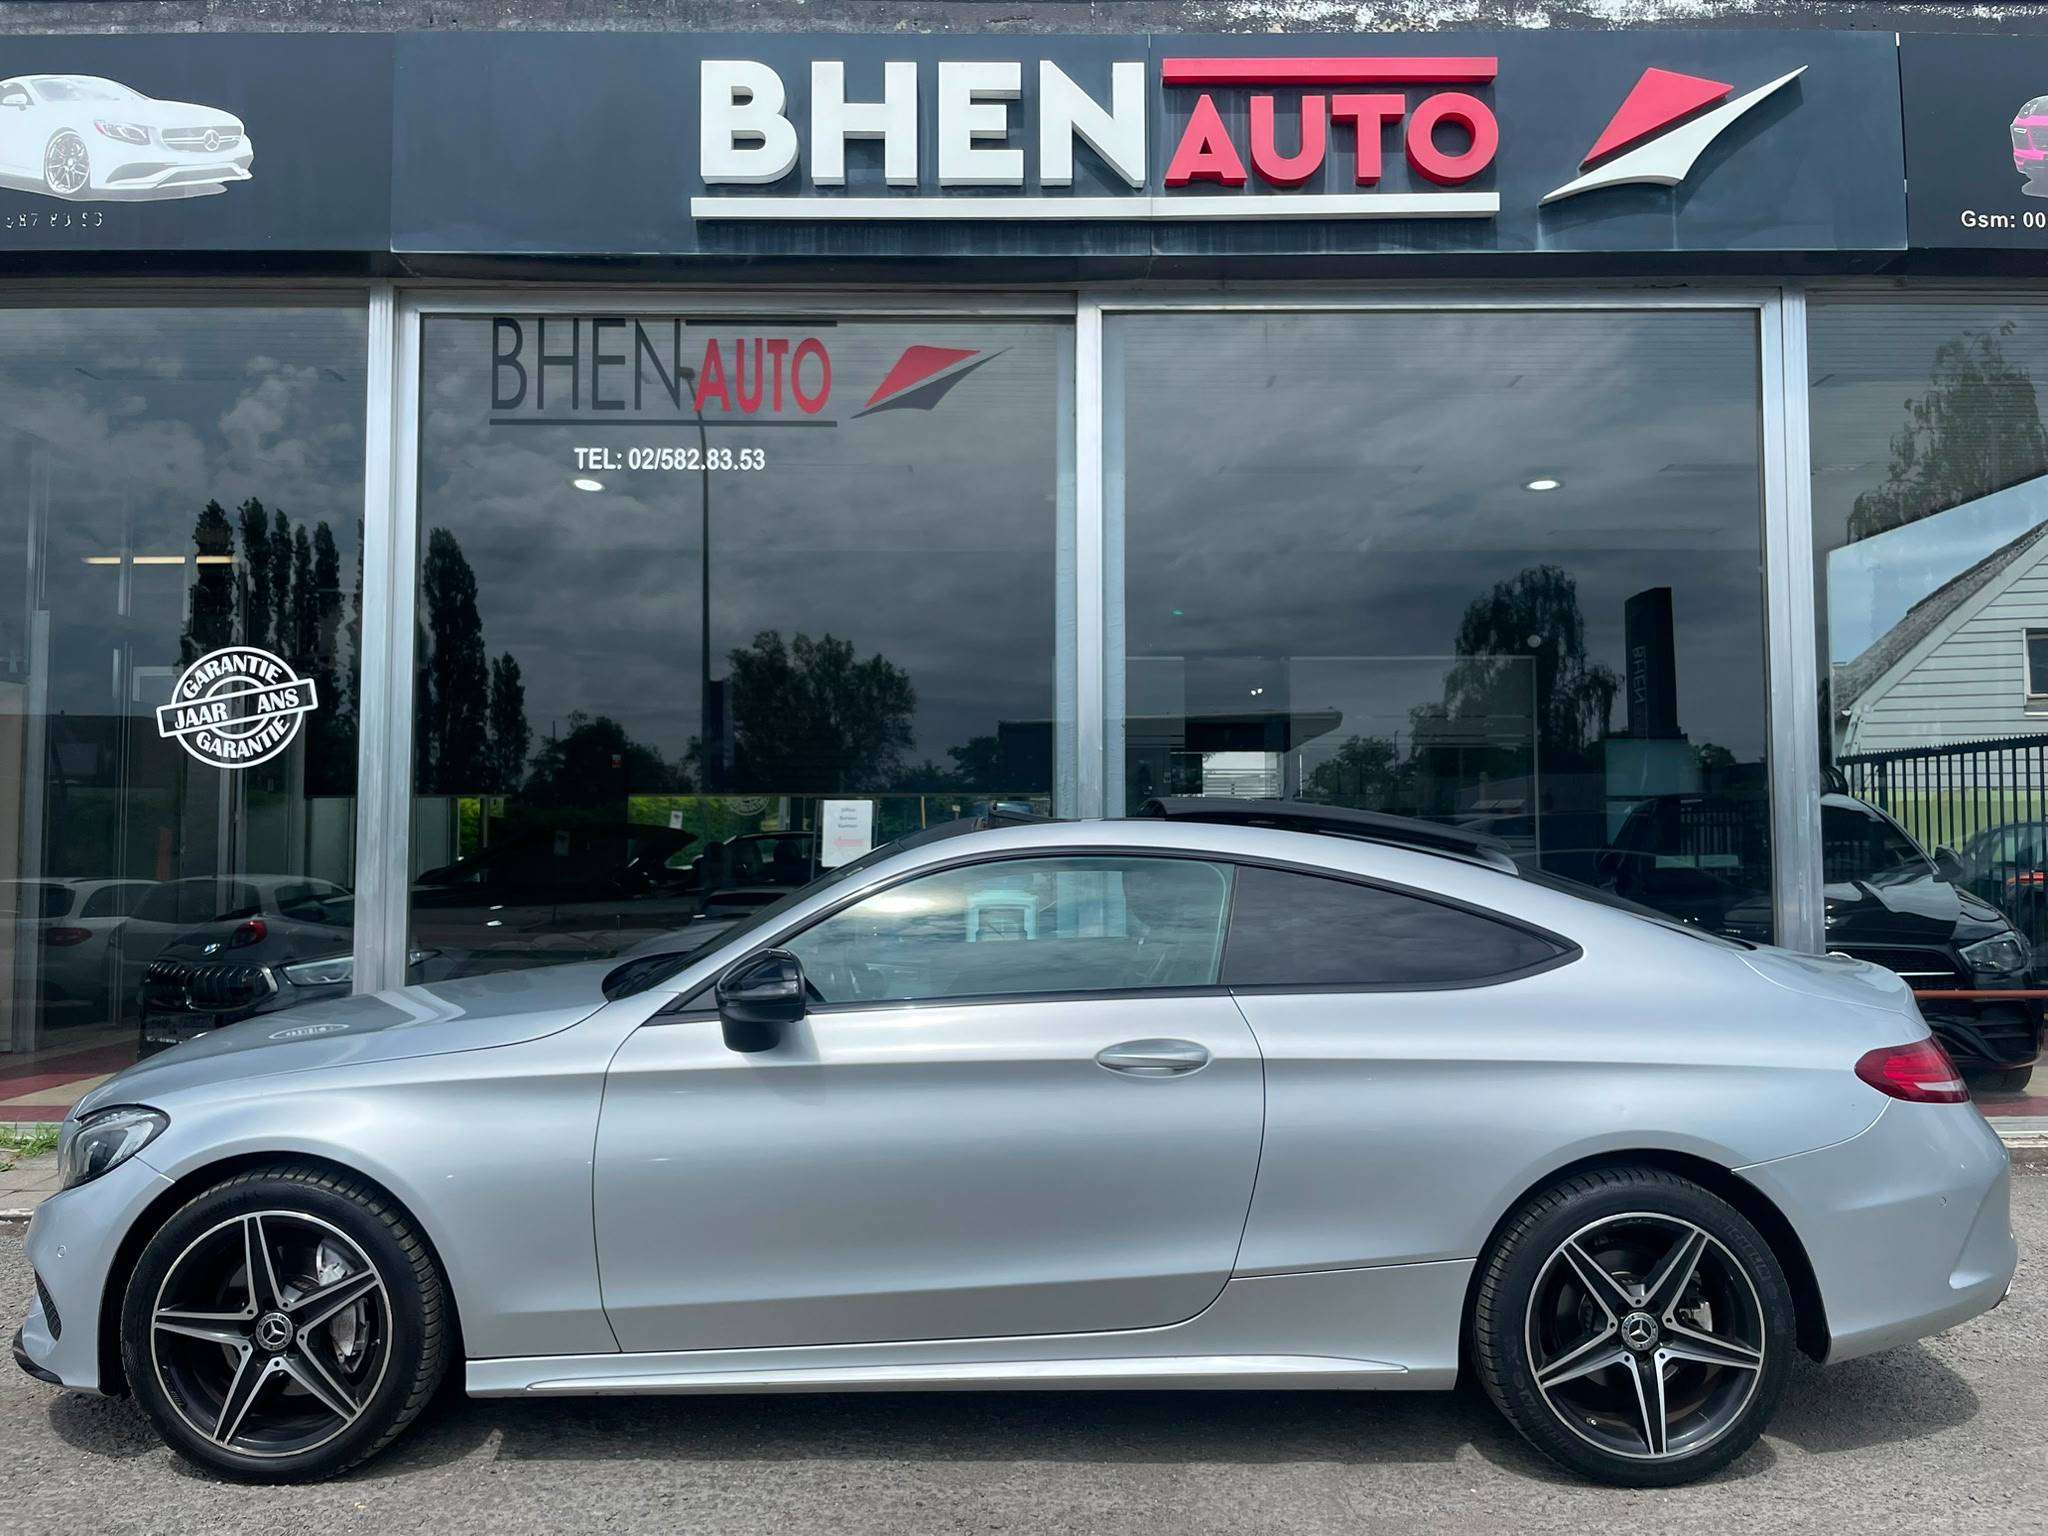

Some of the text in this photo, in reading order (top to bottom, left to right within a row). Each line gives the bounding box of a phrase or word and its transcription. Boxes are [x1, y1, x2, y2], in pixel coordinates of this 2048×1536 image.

[699, 59, 1499, 188] BHEN AUTO
[1961, 209, 2015, 229] Gsm:
[492, 317, 833, 414] BHEN AUTO
[574, 448, 766, 471] TEL: 02/582.83.53
[183, 654, 282, 699] GARANTIE
[174, 688, 300, 730] JAAR ANS
[196, 717, 290, 758] GARANTIE
